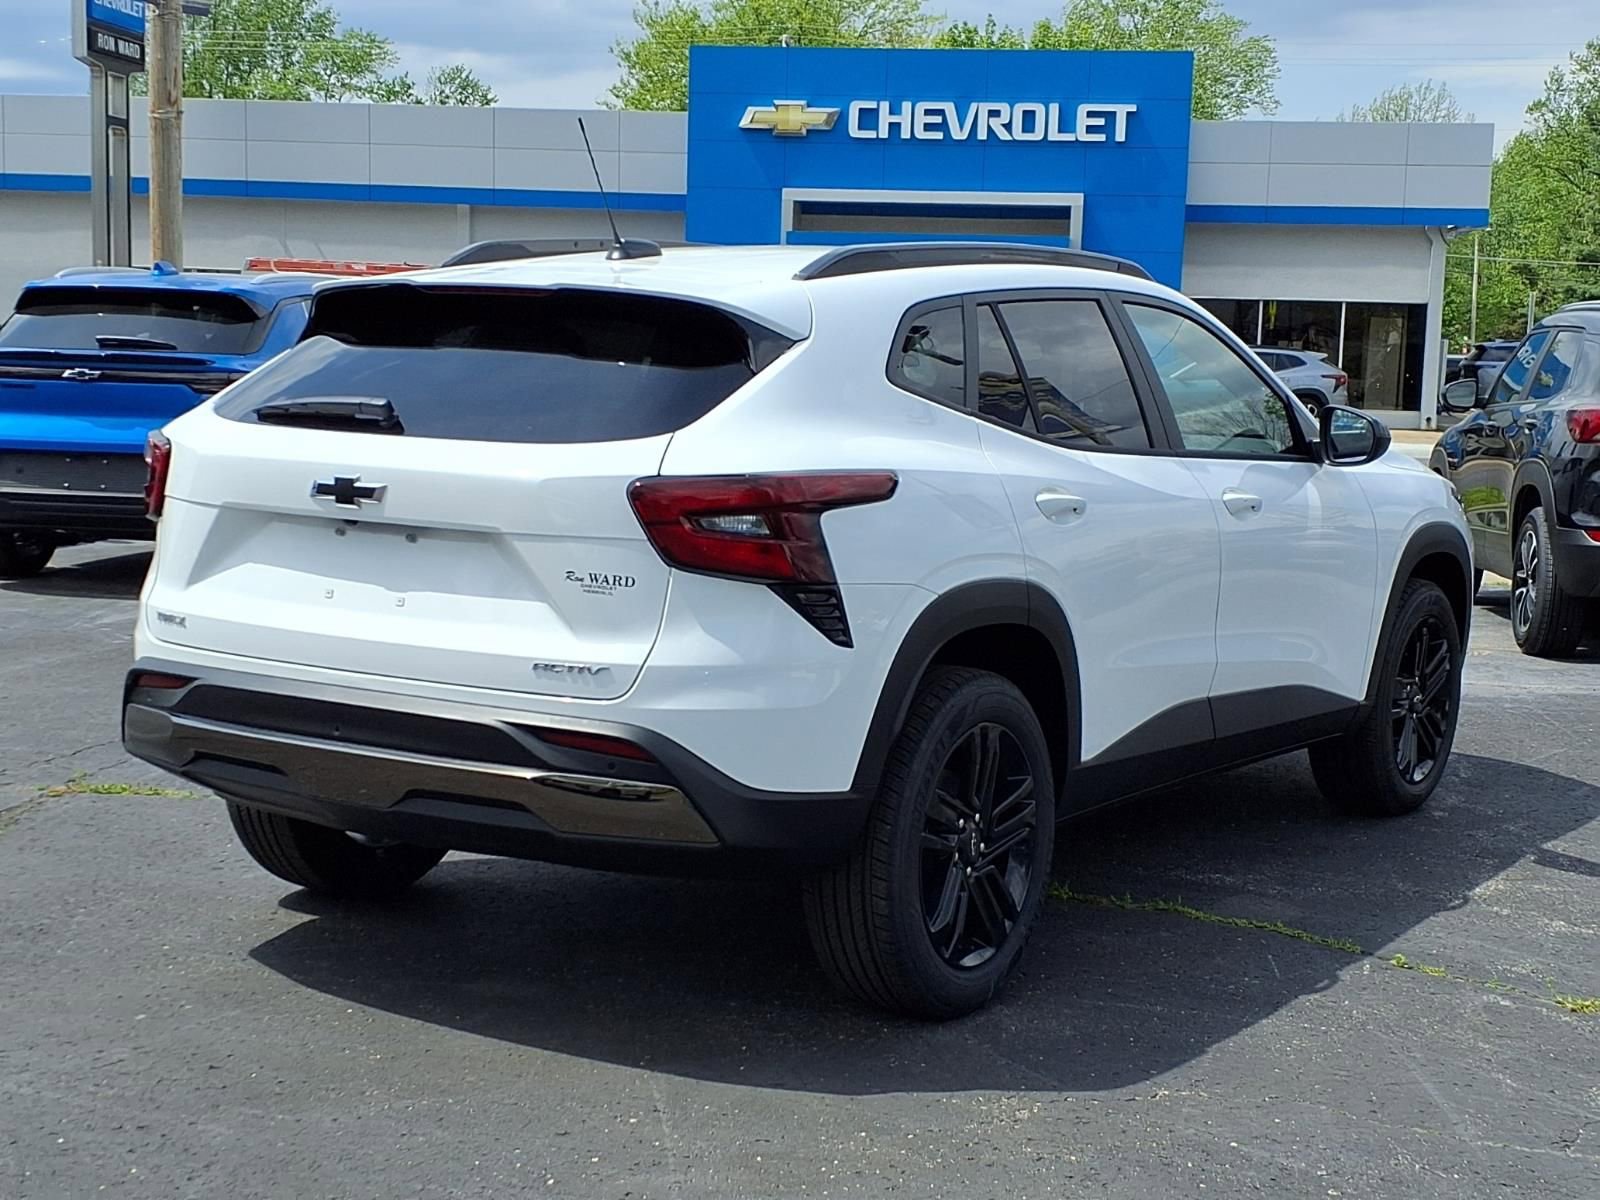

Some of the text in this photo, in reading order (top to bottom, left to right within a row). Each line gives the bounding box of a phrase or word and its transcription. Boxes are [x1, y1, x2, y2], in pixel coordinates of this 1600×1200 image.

[94, 0, 143, 18] EVROLET
[97, 32, 140, 59] RON WARD
[847, 100, 1138, 143] CHEVROLET
[588, 572, 636, 588] WARD
